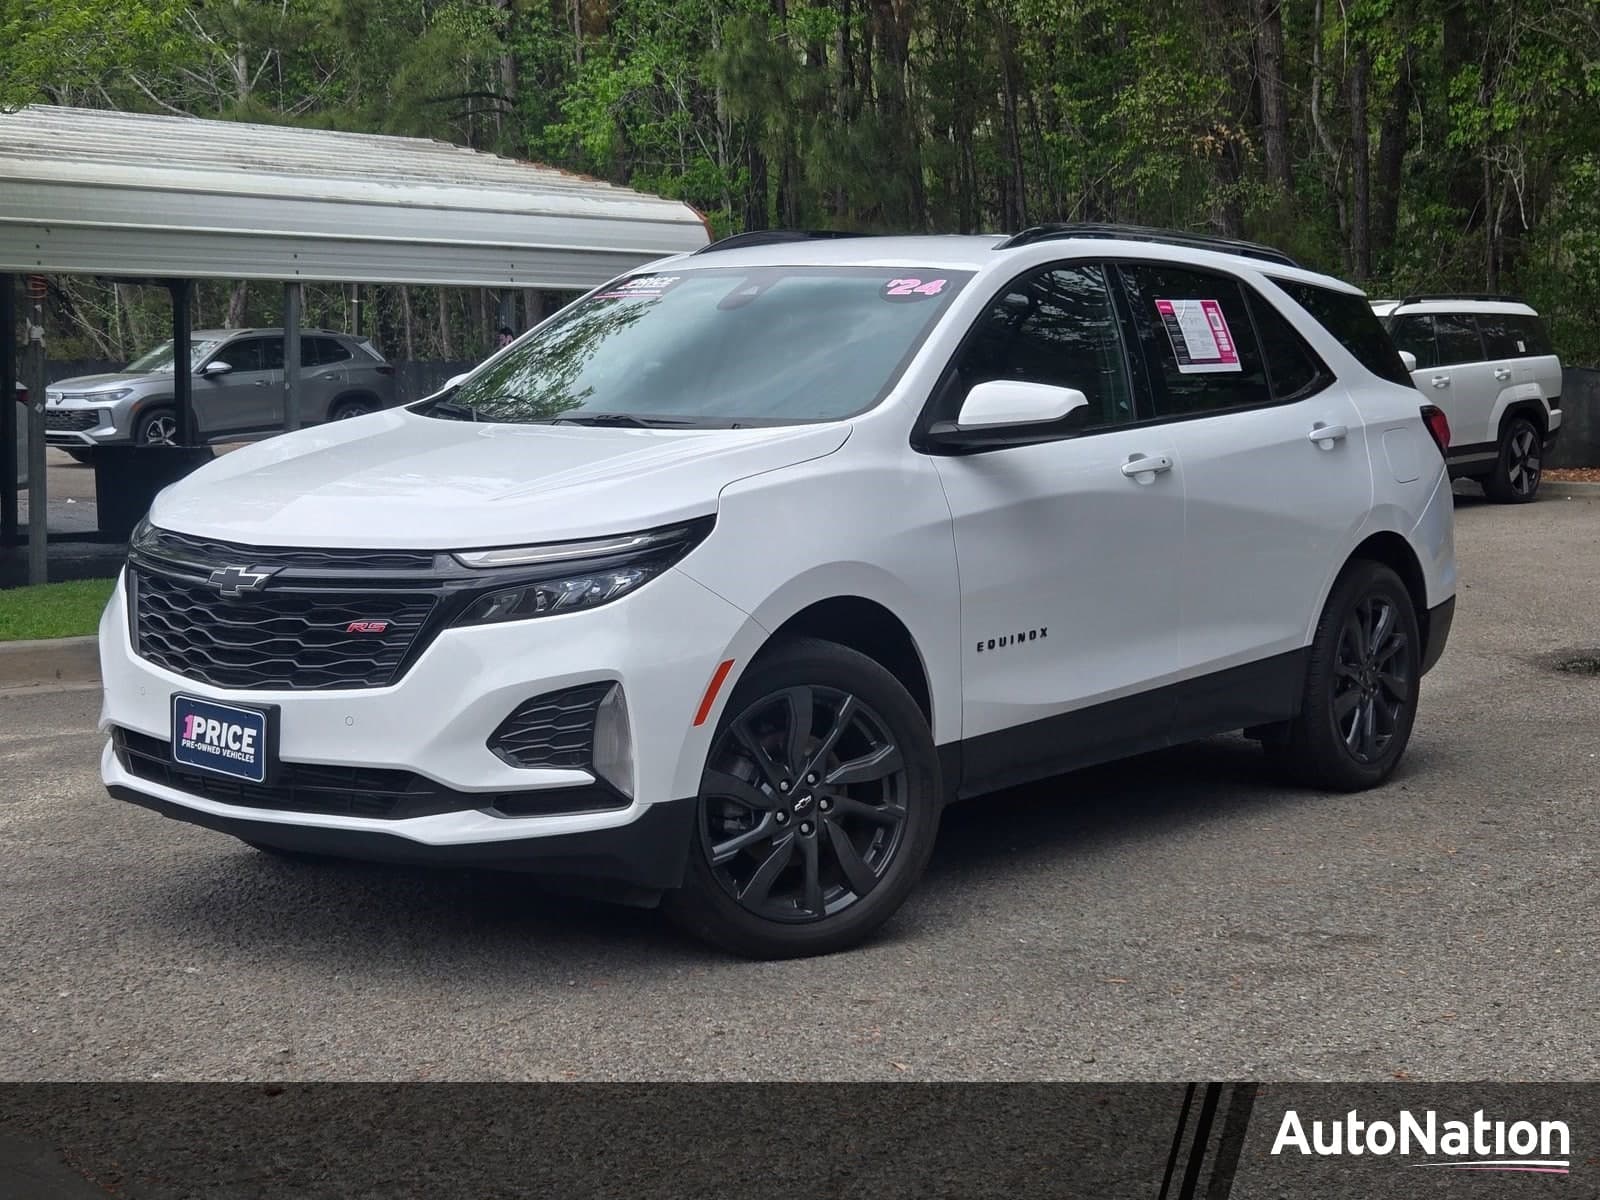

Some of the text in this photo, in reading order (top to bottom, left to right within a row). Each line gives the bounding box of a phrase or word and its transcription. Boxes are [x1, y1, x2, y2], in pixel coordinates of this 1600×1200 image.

[345, 622, 389, 633] RS
[976, 627, 1048, 653] EQUINOX
[181, 739, 255, 764] PRE-OWNED VEHICLES
